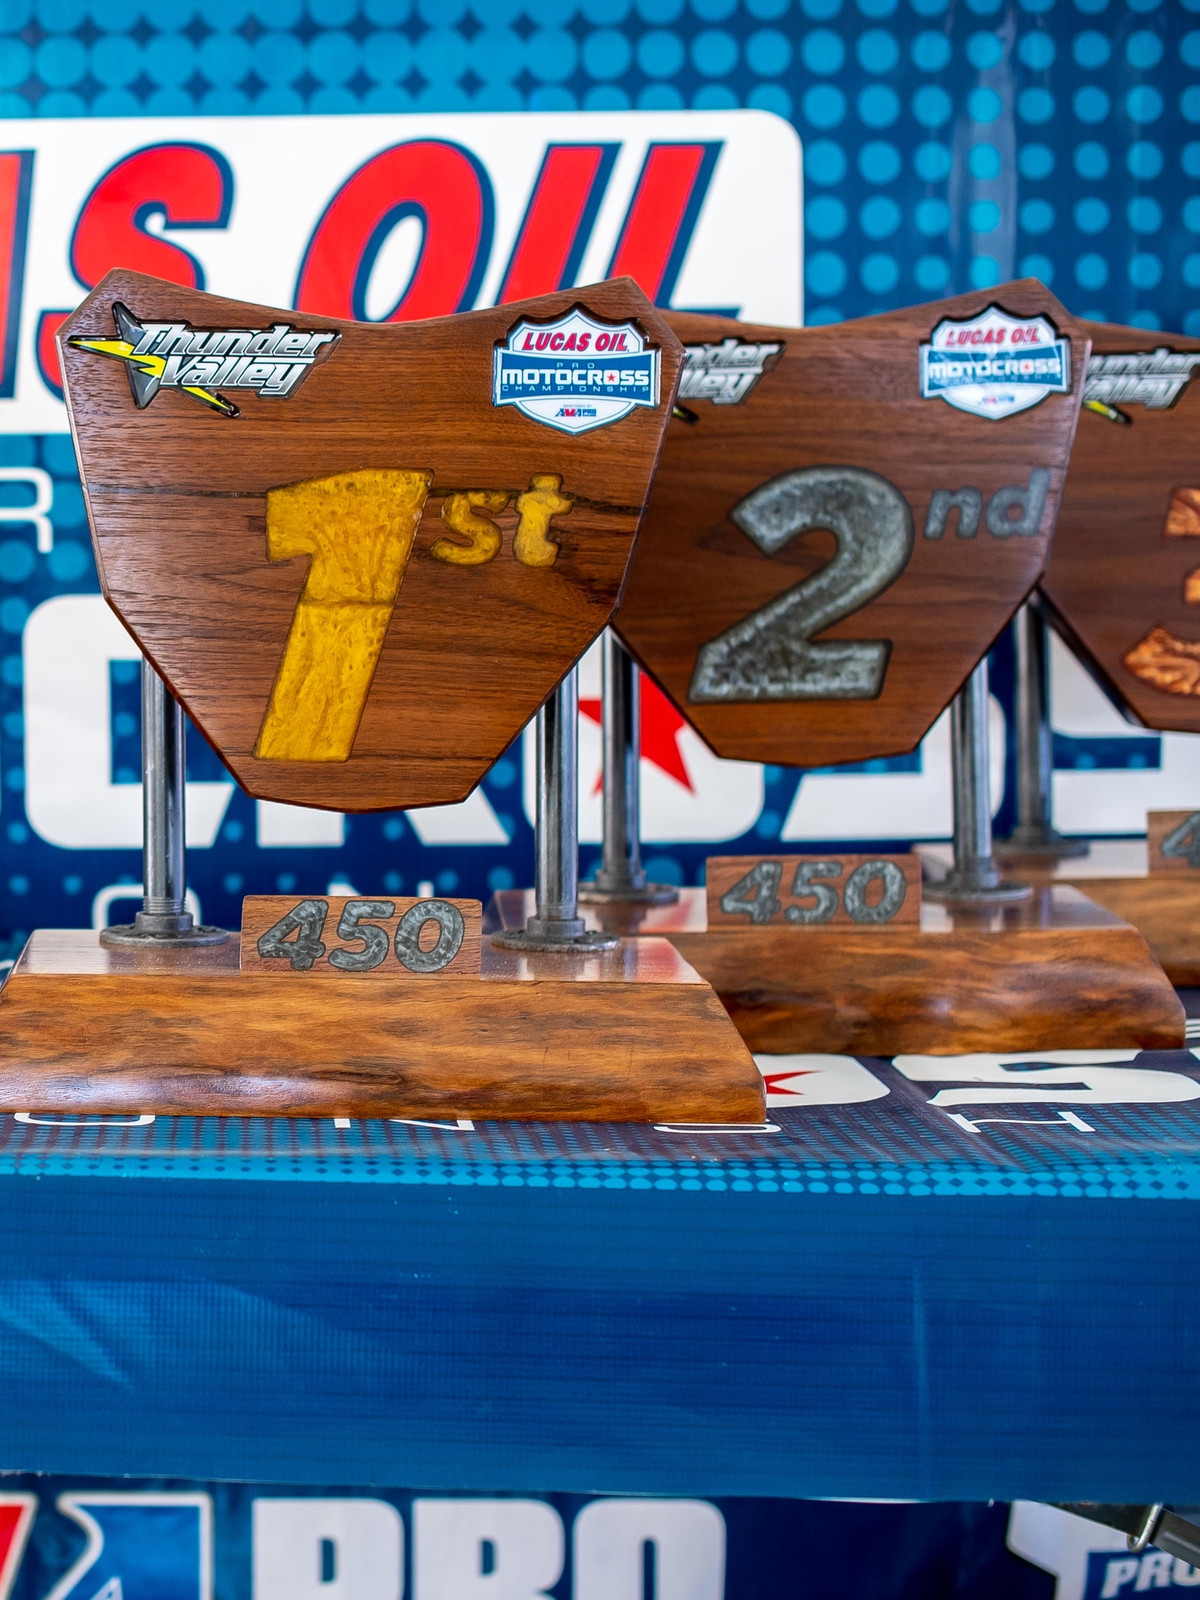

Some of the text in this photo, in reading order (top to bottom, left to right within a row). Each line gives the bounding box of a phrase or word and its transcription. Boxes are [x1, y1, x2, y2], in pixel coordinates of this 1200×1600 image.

[131, 324, 334, 357] Thunder
[522, 332, 629, 352] LUCAS OIL
[684, 339, 780, 368] nder
[946, 328, 1007, 347] LUCAS
[160, 355, 315, 395] Valley
[502, 369, 650, 386] MOTOCROSS
[677, 366, 763, 404] lley
[929, 358, 1062, 379] MOTOCROSS
[501, 384, 650, 393] CHAMPIONSHIP
[688, 463, 1054, 704] 2nd
[252, 467, 573, 763] 1st
[720, 859, 907, 925] 450
[256, 898, 466, 973] 450
